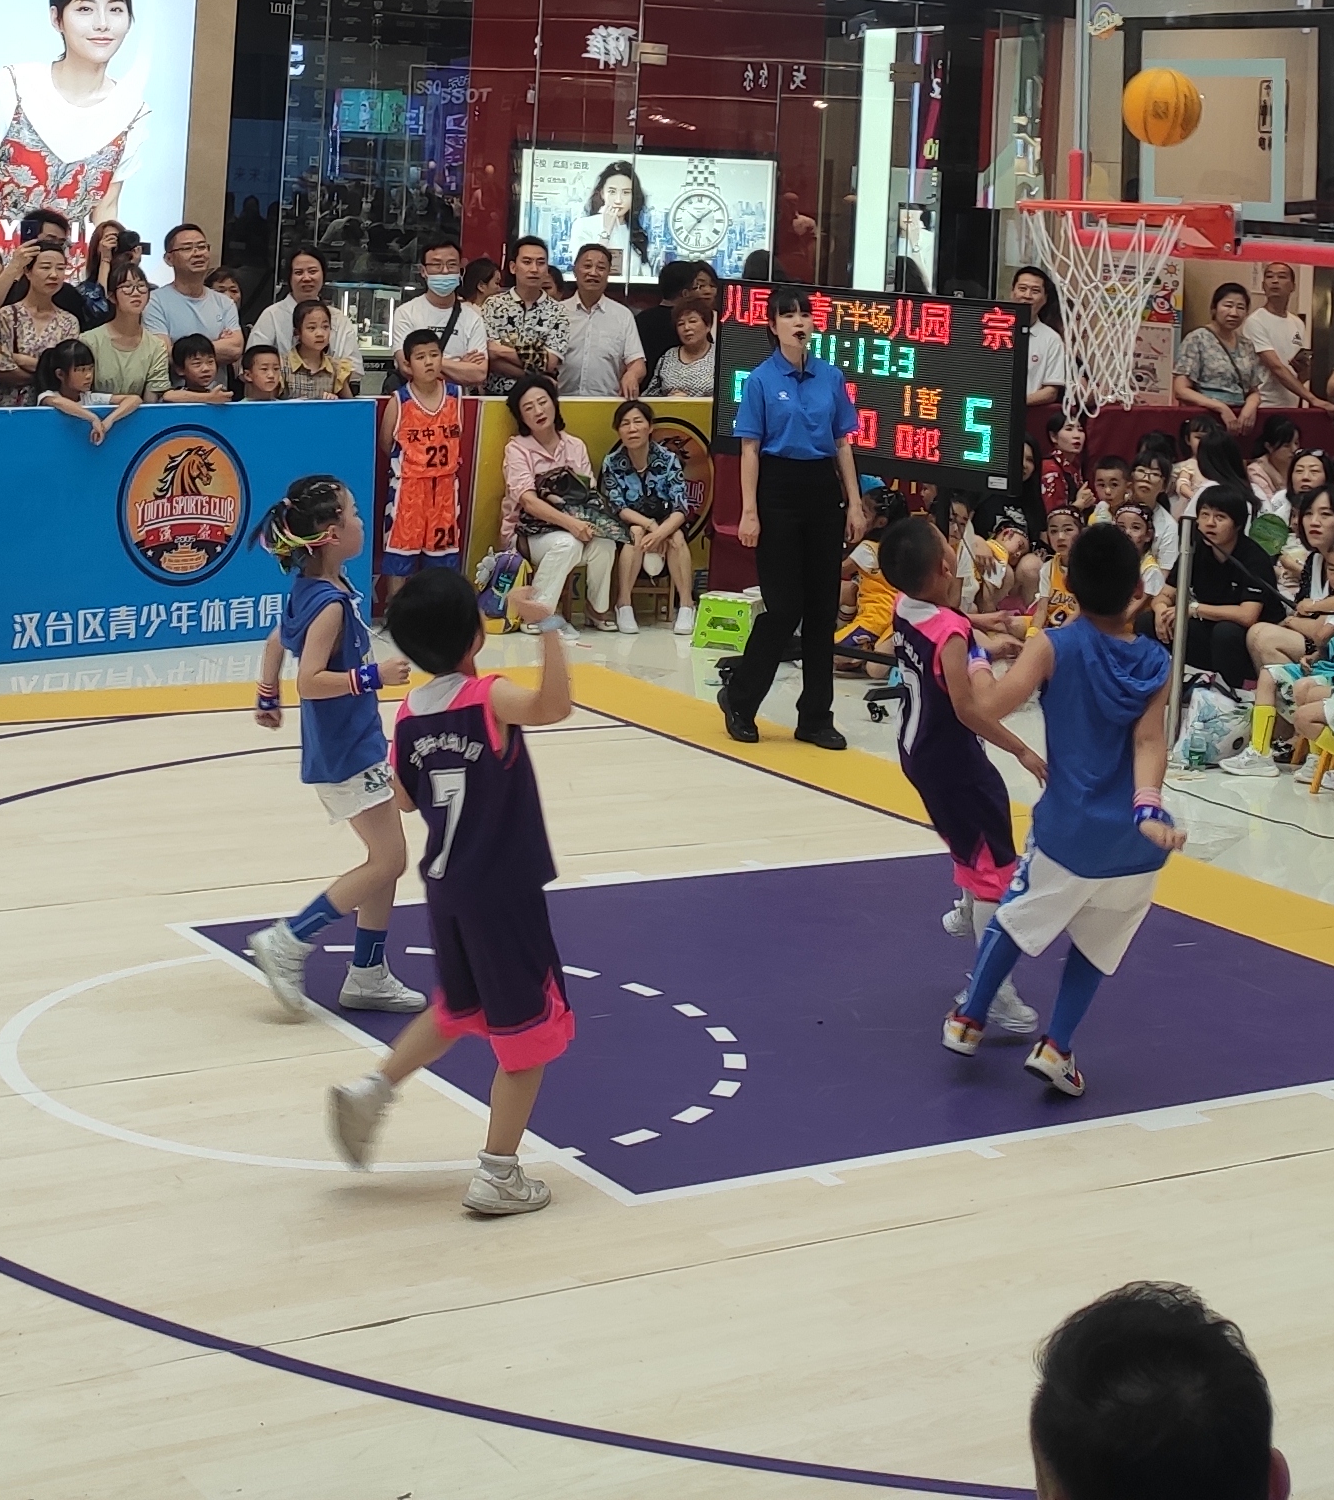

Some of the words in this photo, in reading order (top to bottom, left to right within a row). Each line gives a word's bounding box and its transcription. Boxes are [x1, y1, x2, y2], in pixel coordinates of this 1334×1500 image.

[981, 307, 1016, 350] 宗
[963, 396, 994, 463] 5
[425, 445, 449, 468] 23
[172, 495, 210, 516] SPORTS
[210, 495, 236, 523] CLUB
[427, 766, 467, 880] 7
